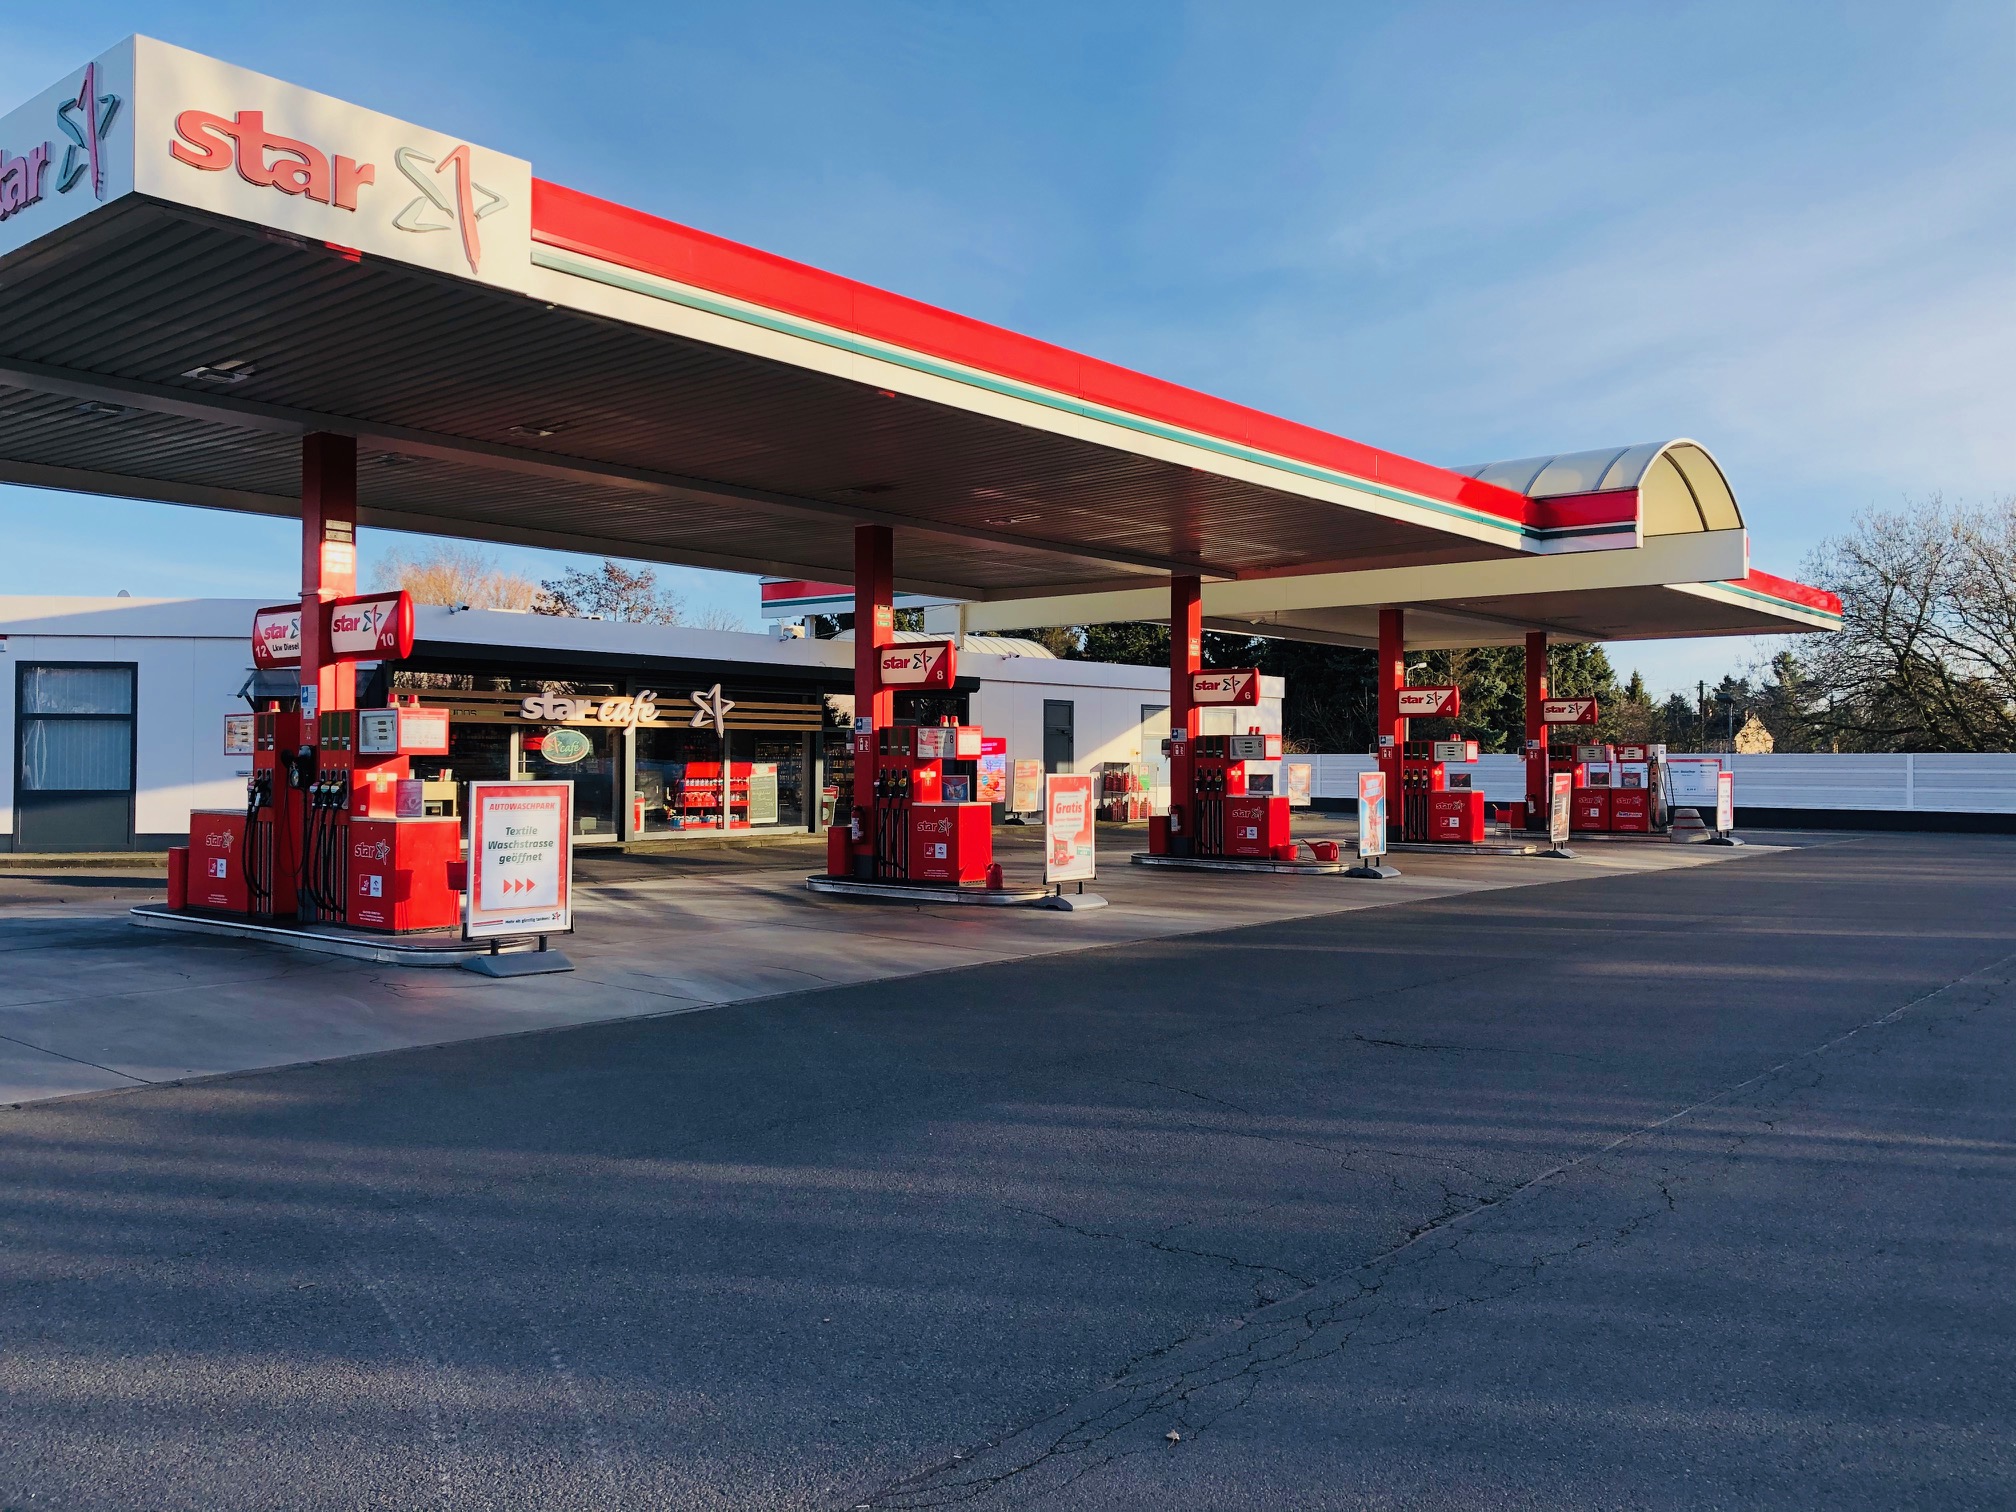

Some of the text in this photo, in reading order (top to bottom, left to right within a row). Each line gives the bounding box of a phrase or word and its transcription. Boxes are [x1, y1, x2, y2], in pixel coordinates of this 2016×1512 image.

[170, 110, 375, 211] star
[333, 614, 360, 633] star
[264, 622, 288, 640] star
[380, 633, 394, 647] 10
[255, 645, 268, 658] 12
[272, 642, 300, 652] Lkw Diesel
[882, 656, 911, 670] star
[936, 670, 944, 680] 8
[1194, 680, 1221, 691] star
[1244, 691, 1251, 700] 6
[1400, 695, 1424, 704] star
[520, 689, 661, 736] star café
[1545, 705, 1567, 714] star
[949, 734, 954, 744] 8
[559, 741, 581, 757] café
[489, 802, 556, 811] AUTOWASCHPARK
[1055, 802, 1082, 814] Gratis
[1232, 808, 1250, 819] star
[505, 826, 538, 836] Textile
[917, 820, 938, 832] star
[206, 832, 222, 847] star
[488, 839, 554, 850] Waschstrasse
[354, 842, 375, 858] star
[499, 852, 543, 865] geöffnet
